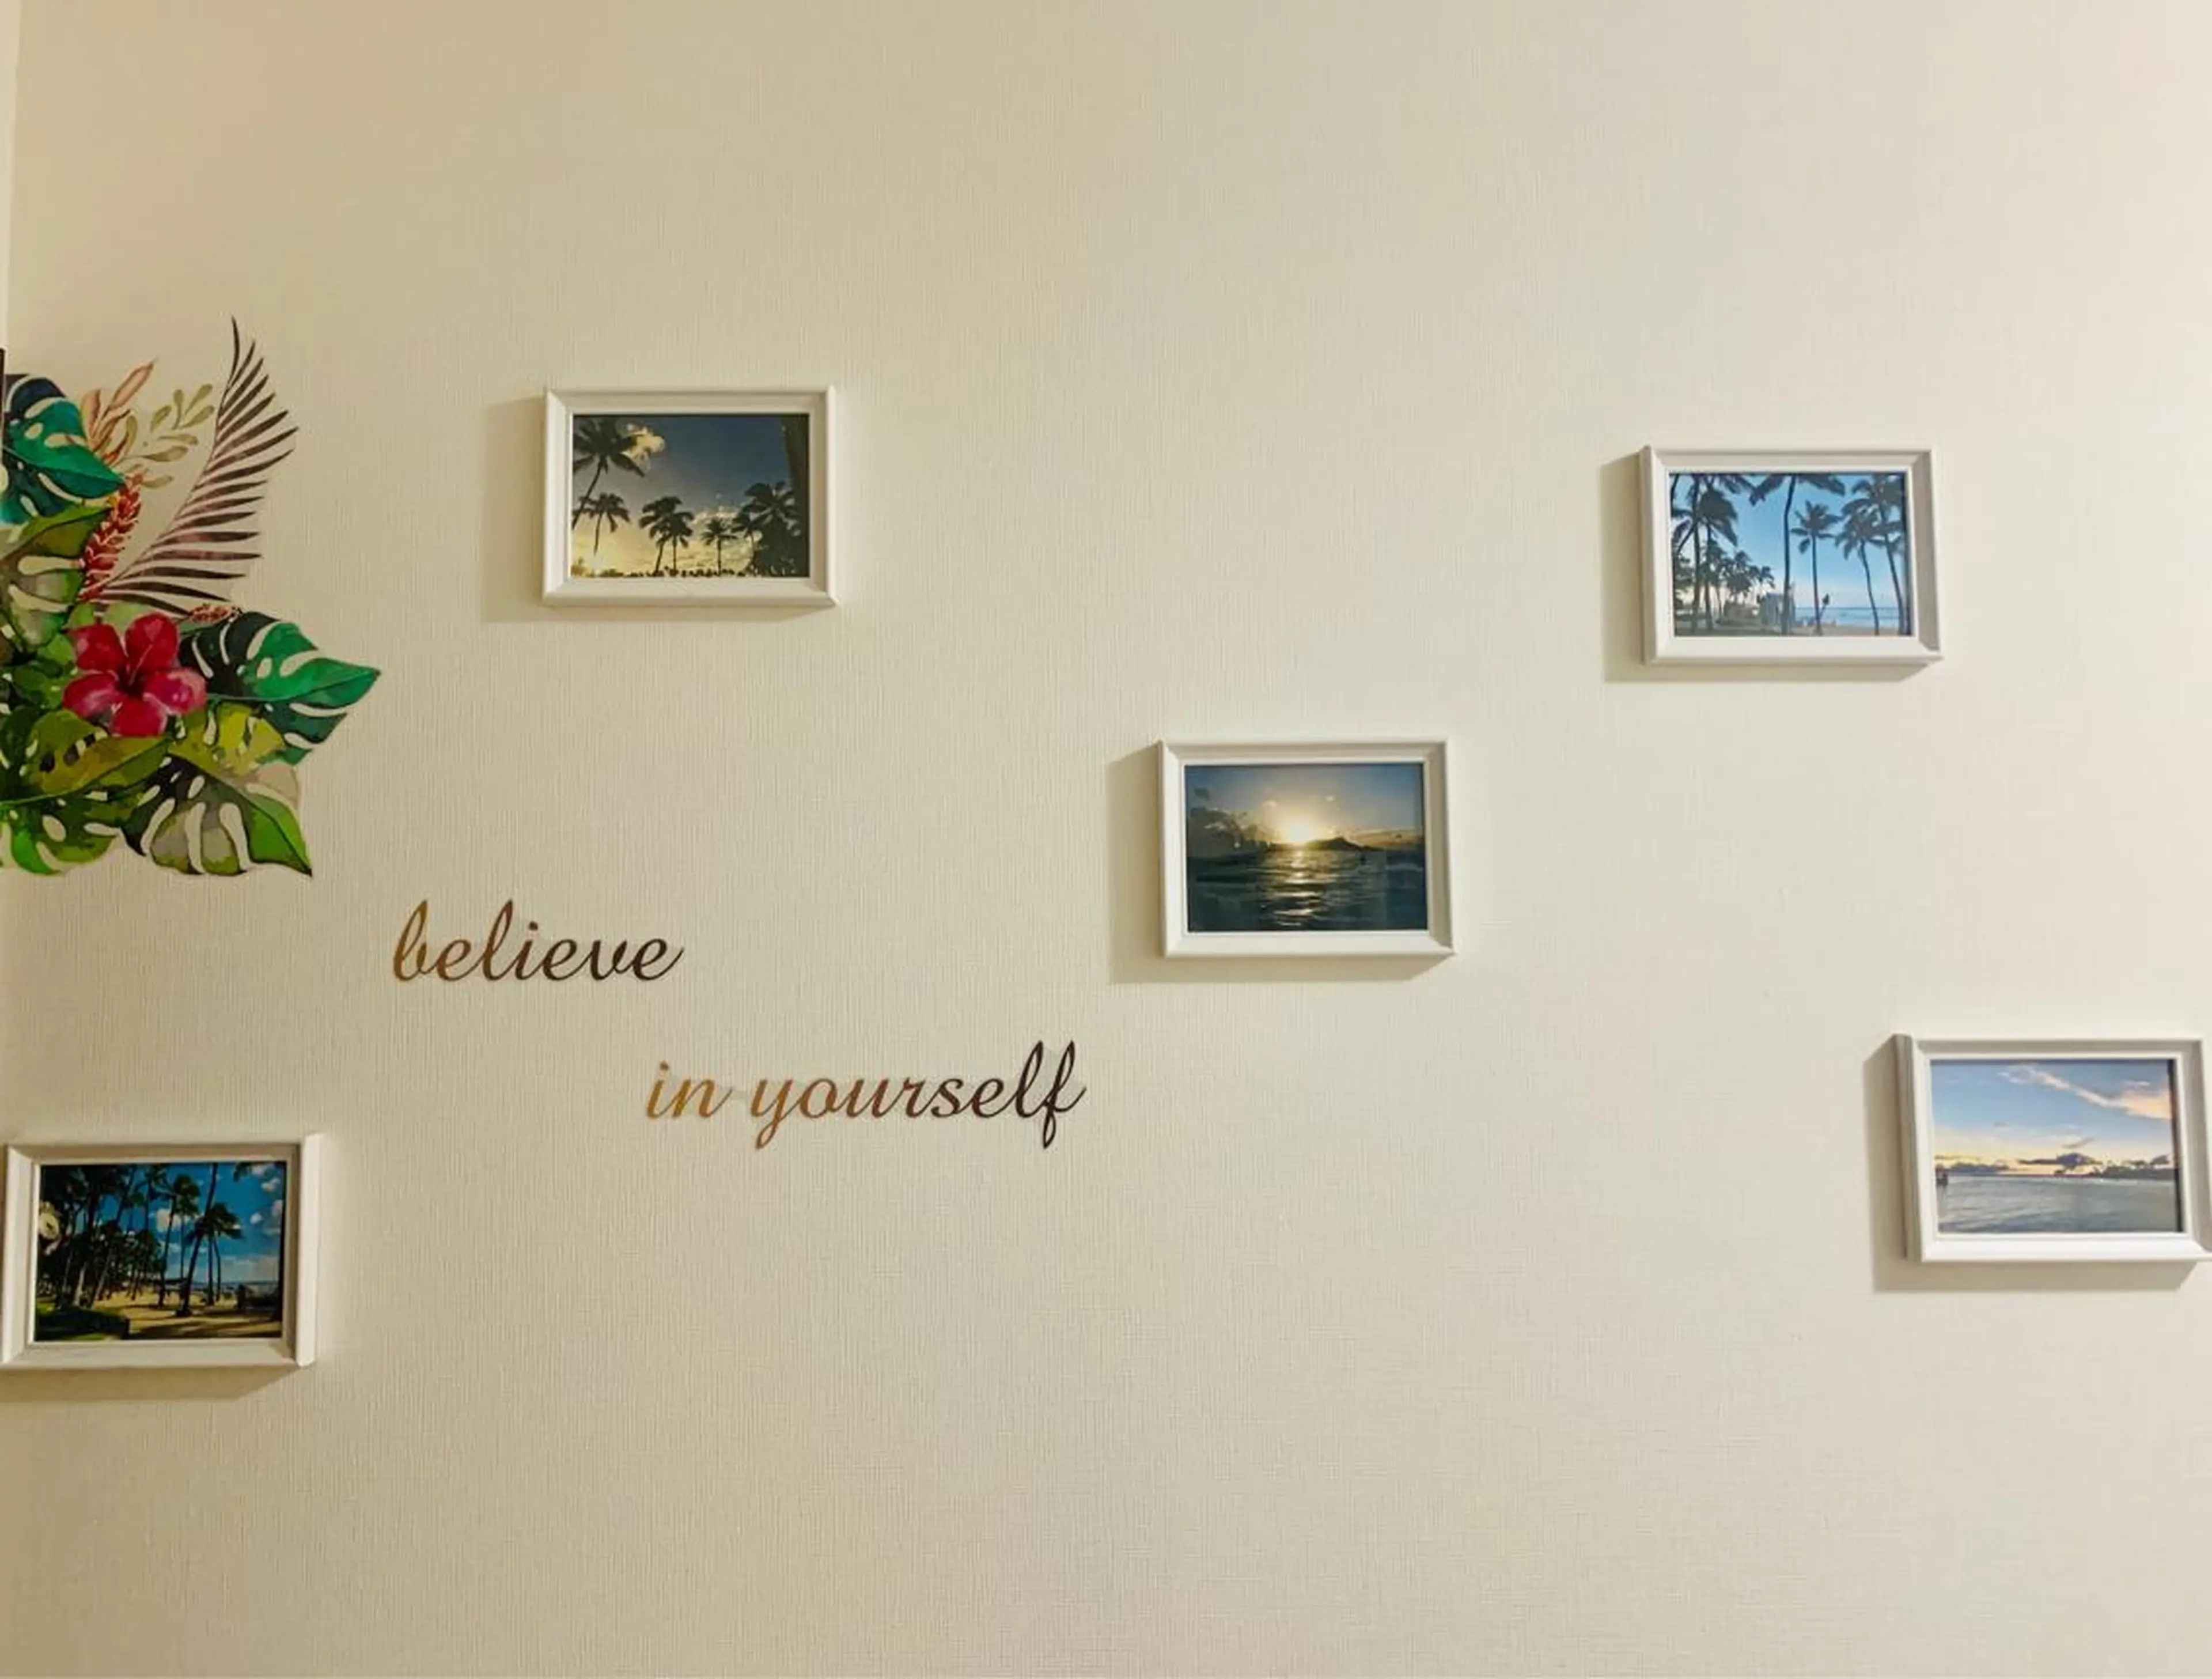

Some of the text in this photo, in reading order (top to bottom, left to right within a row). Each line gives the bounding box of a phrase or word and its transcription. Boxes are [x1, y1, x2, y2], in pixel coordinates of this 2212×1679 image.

[393, 899, 684, 982] believe
[645, 1040, 1088, 1150] in yourself
